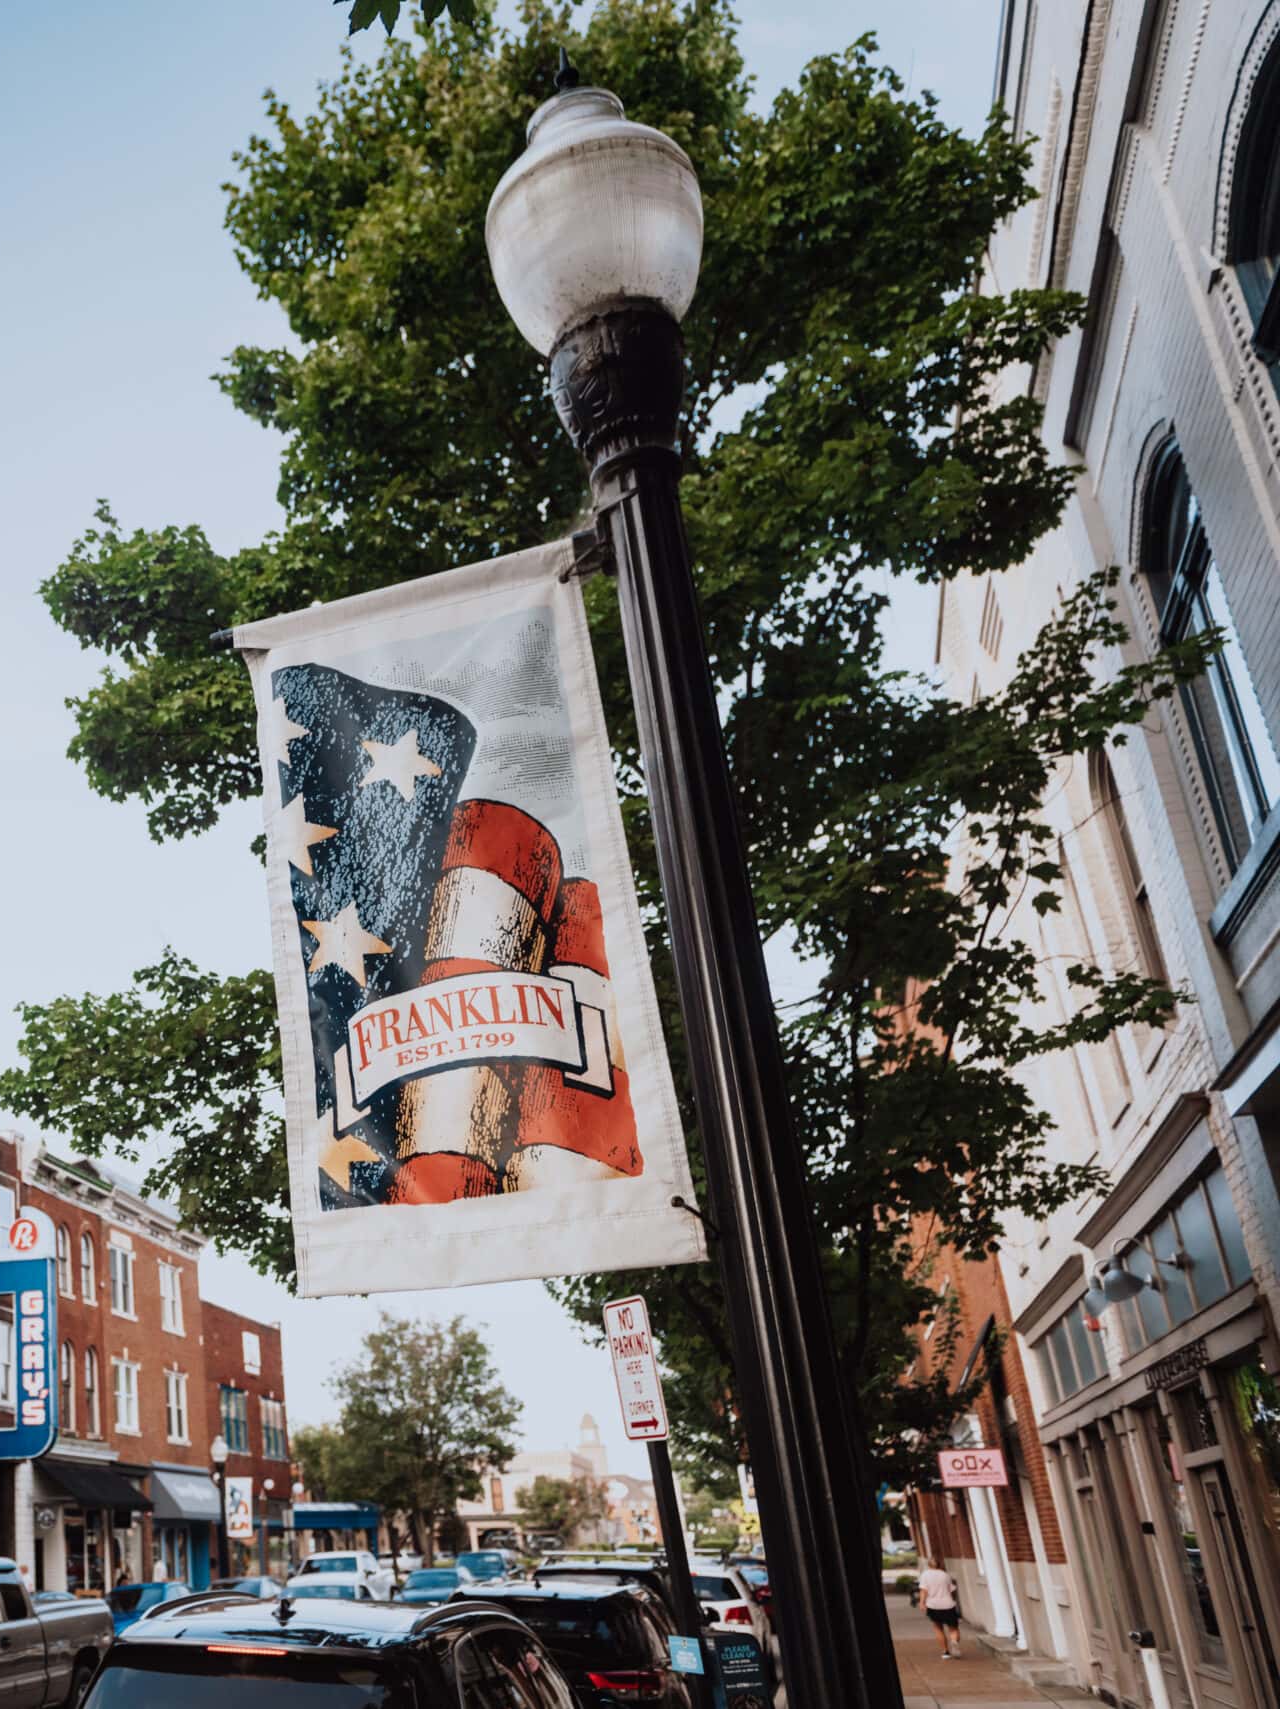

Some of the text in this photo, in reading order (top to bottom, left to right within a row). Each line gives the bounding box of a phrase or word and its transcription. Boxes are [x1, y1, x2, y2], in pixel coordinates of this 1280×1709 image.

[352, 984, 566, 1071] FRANKLIN
[617, 1306, 634, 1330] NO
[20, 1290, 49, 1425] GRAY'S
[612, 1331, 649, 1359] PARKING
[626, 1360, 643, 1374] HERE
[629, 1399, 654, 1415] CORNER
